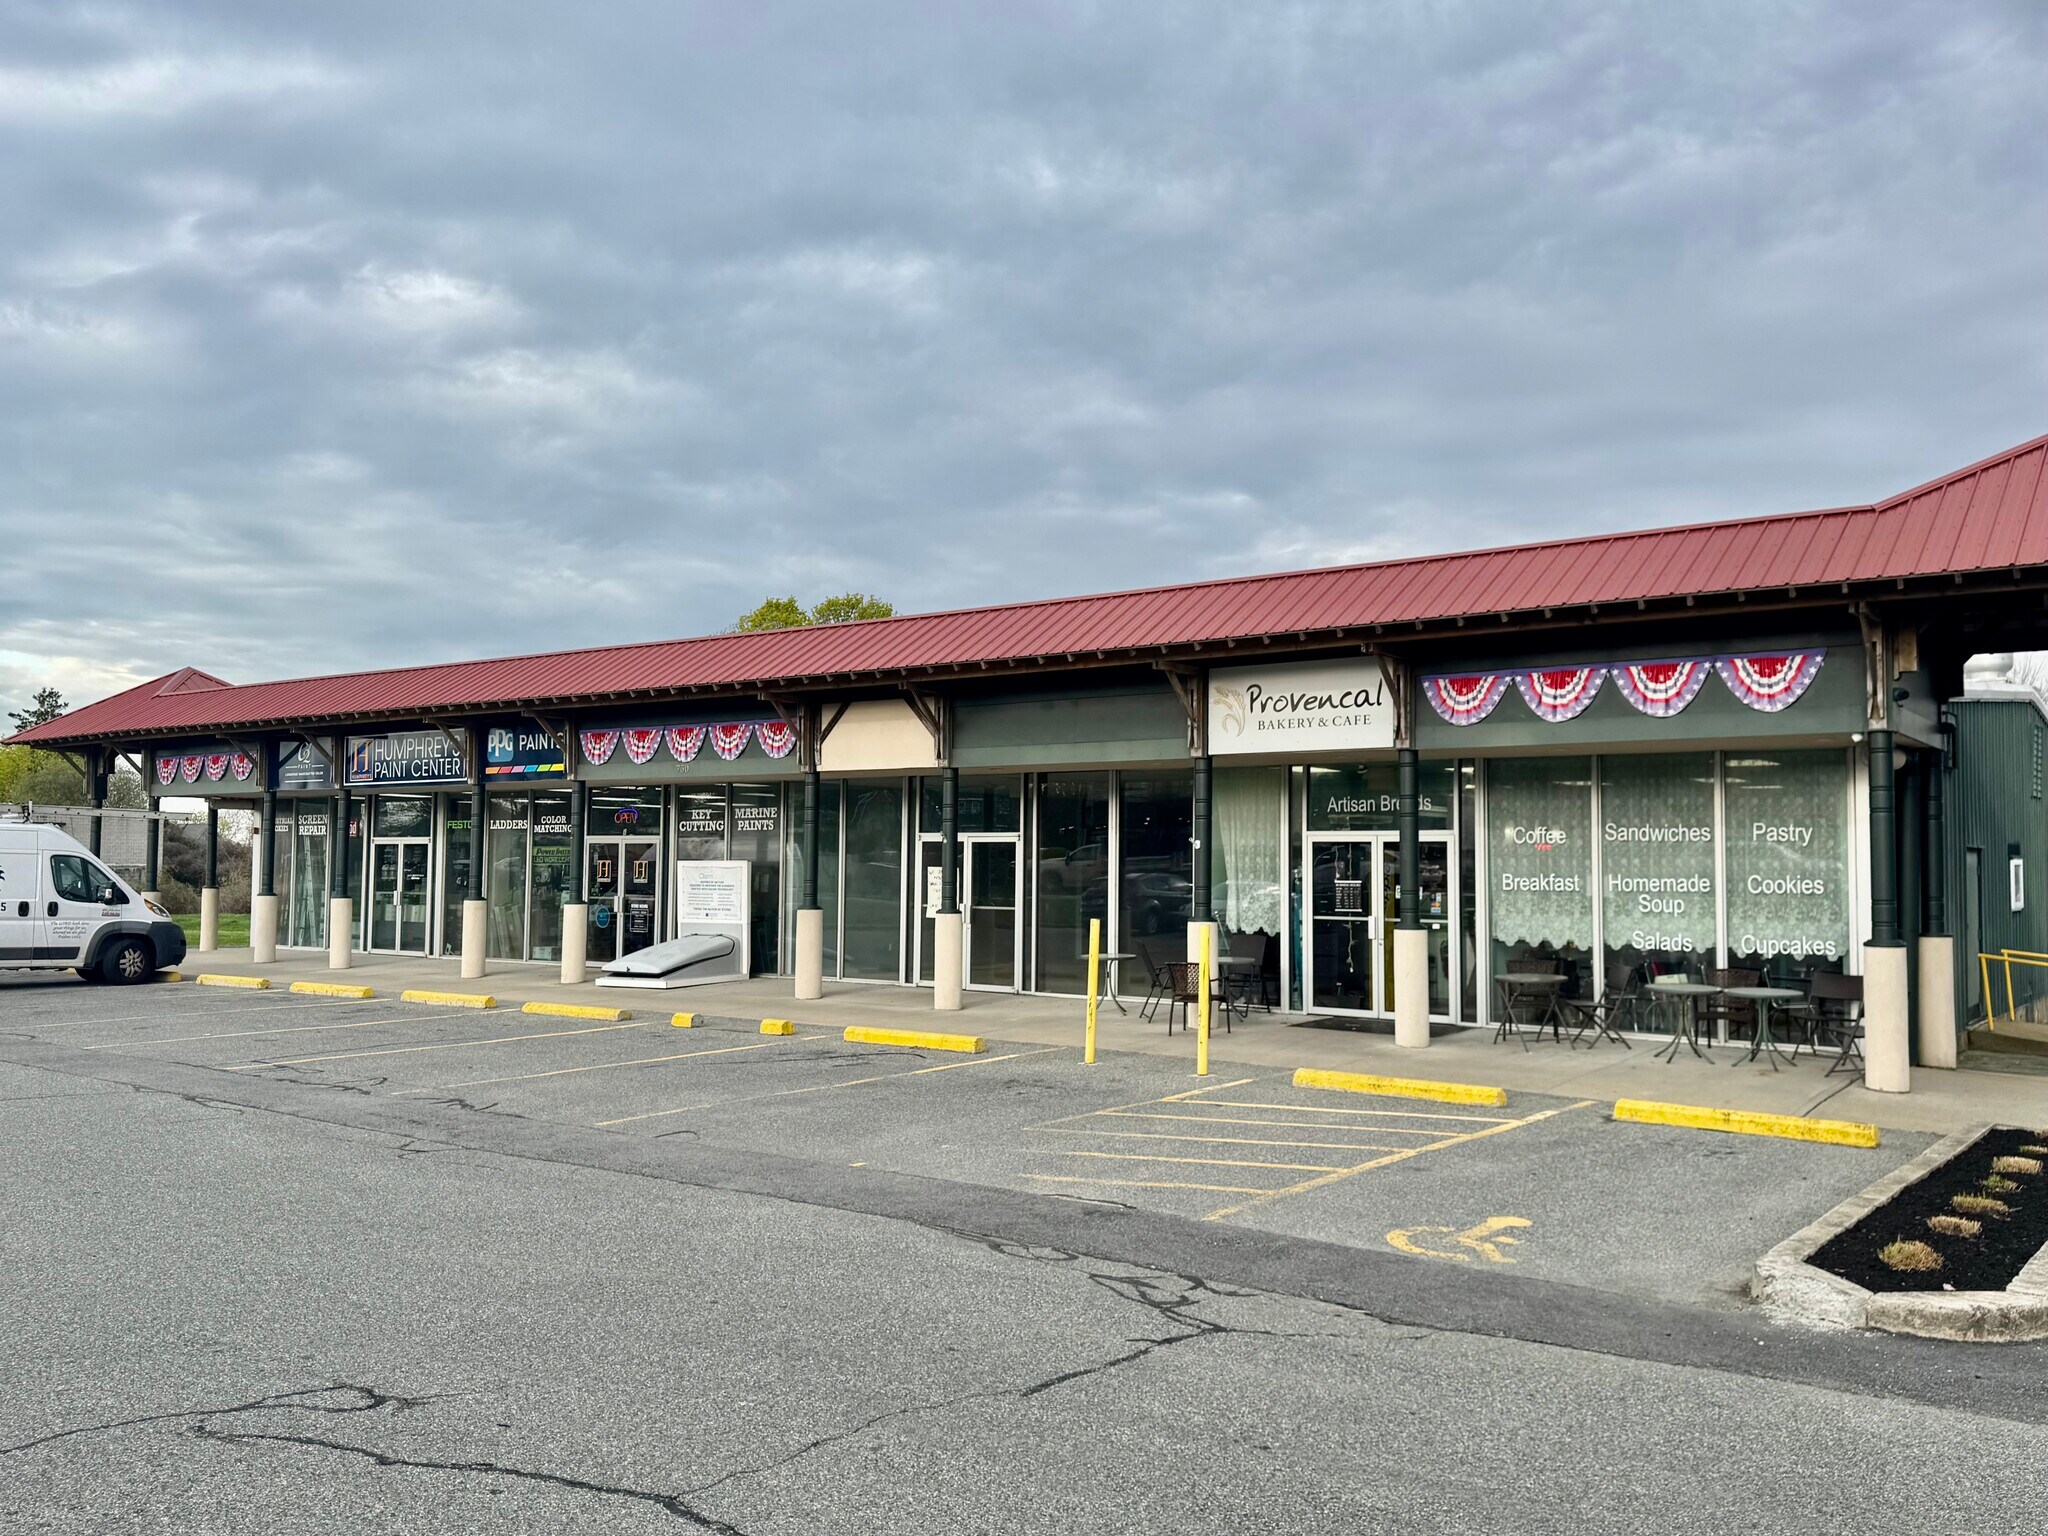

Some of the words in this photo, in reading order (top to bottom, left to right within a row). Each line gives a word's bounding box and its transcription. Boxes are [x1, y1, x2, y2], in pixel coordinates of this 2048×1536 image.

[1246, 677, 1383, 714] Provencal
[1258, 717, 1315, 731] BAKERY
[1318, 718, 1329, 728] &
[1332, 714, 1372, 727] CAFE
[488, 729, 513, 757] PPG
[374, 760, 407, 779] PAINT
[411, 758, 461, 777] CENTER
[734, 807, 778, 819] MARINE
[1327, 796, 1376, 813] Artisan
[1381, 794, 1432, 812] Breds
[298, 814, 328, 824] SCREEN
[540, 815, 567, 824] COLOR
[614, 813, 637, 824] OPEN
[691, 809, 712, 820] KEY
[298, 825, 327, 836] REPAIR
[490, 820, 528, 830] LADDERS
[679, 820, 724, 832] CUTTING
[737, 820, 774, 831] PAINTS
[1605, 823, 1711, 842] Sandwiches
[1752, 822, 1813, 847] Pastry
[1513, 826, 1567, 845] Coffee
[1502, 873, 1580, 892] Breakfast
[1608, 873, 1711, 893] Homemade
[1747, 874, 1824, 895] Cookies
[1638, 894, 1685, 917] Soup
[1632, 930, 1693, 952] Salads
[1741, 934, 1836, 959] Cupcakes
